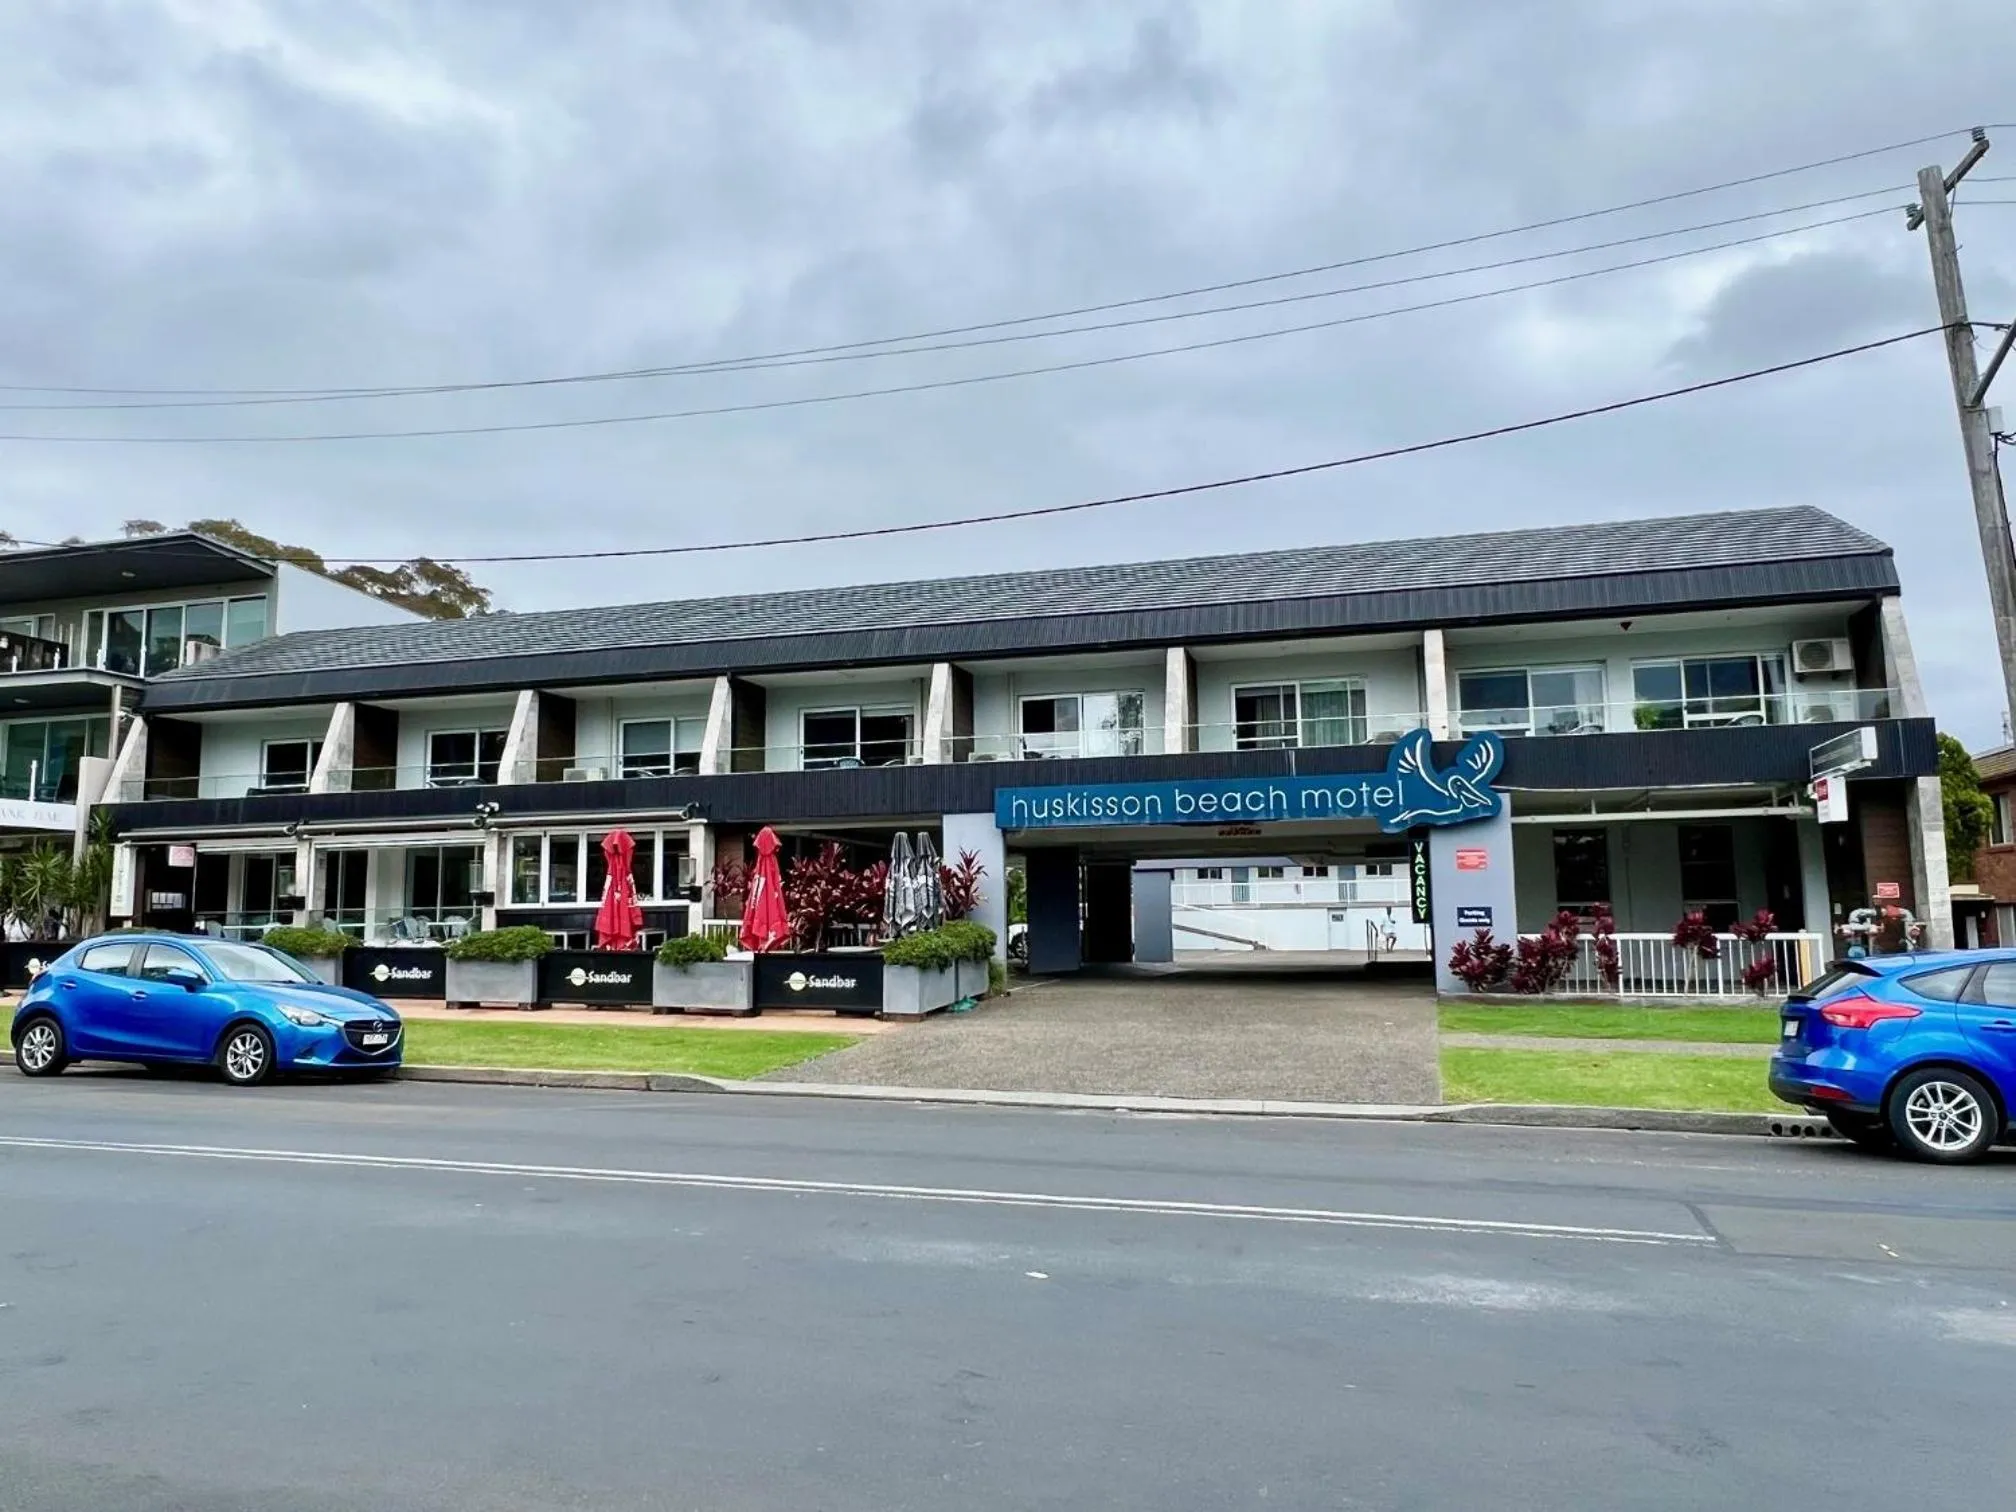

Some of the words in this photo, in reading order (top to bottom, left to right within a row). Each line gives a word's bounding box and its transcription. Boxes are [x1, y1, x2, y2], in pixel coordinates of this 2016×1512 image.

[1012, 791, 1161, 818] huskisson
[1174, 785, 1288, 813] beach
[1301, 780, 1403, 809] motel
[1414, 842, 1427, 919] VACANCY
[391, 967, 432, 979] Sandbar
[588, 970, 632, 983] Sandbar
[808, 975, 857, 988] Sandbar
